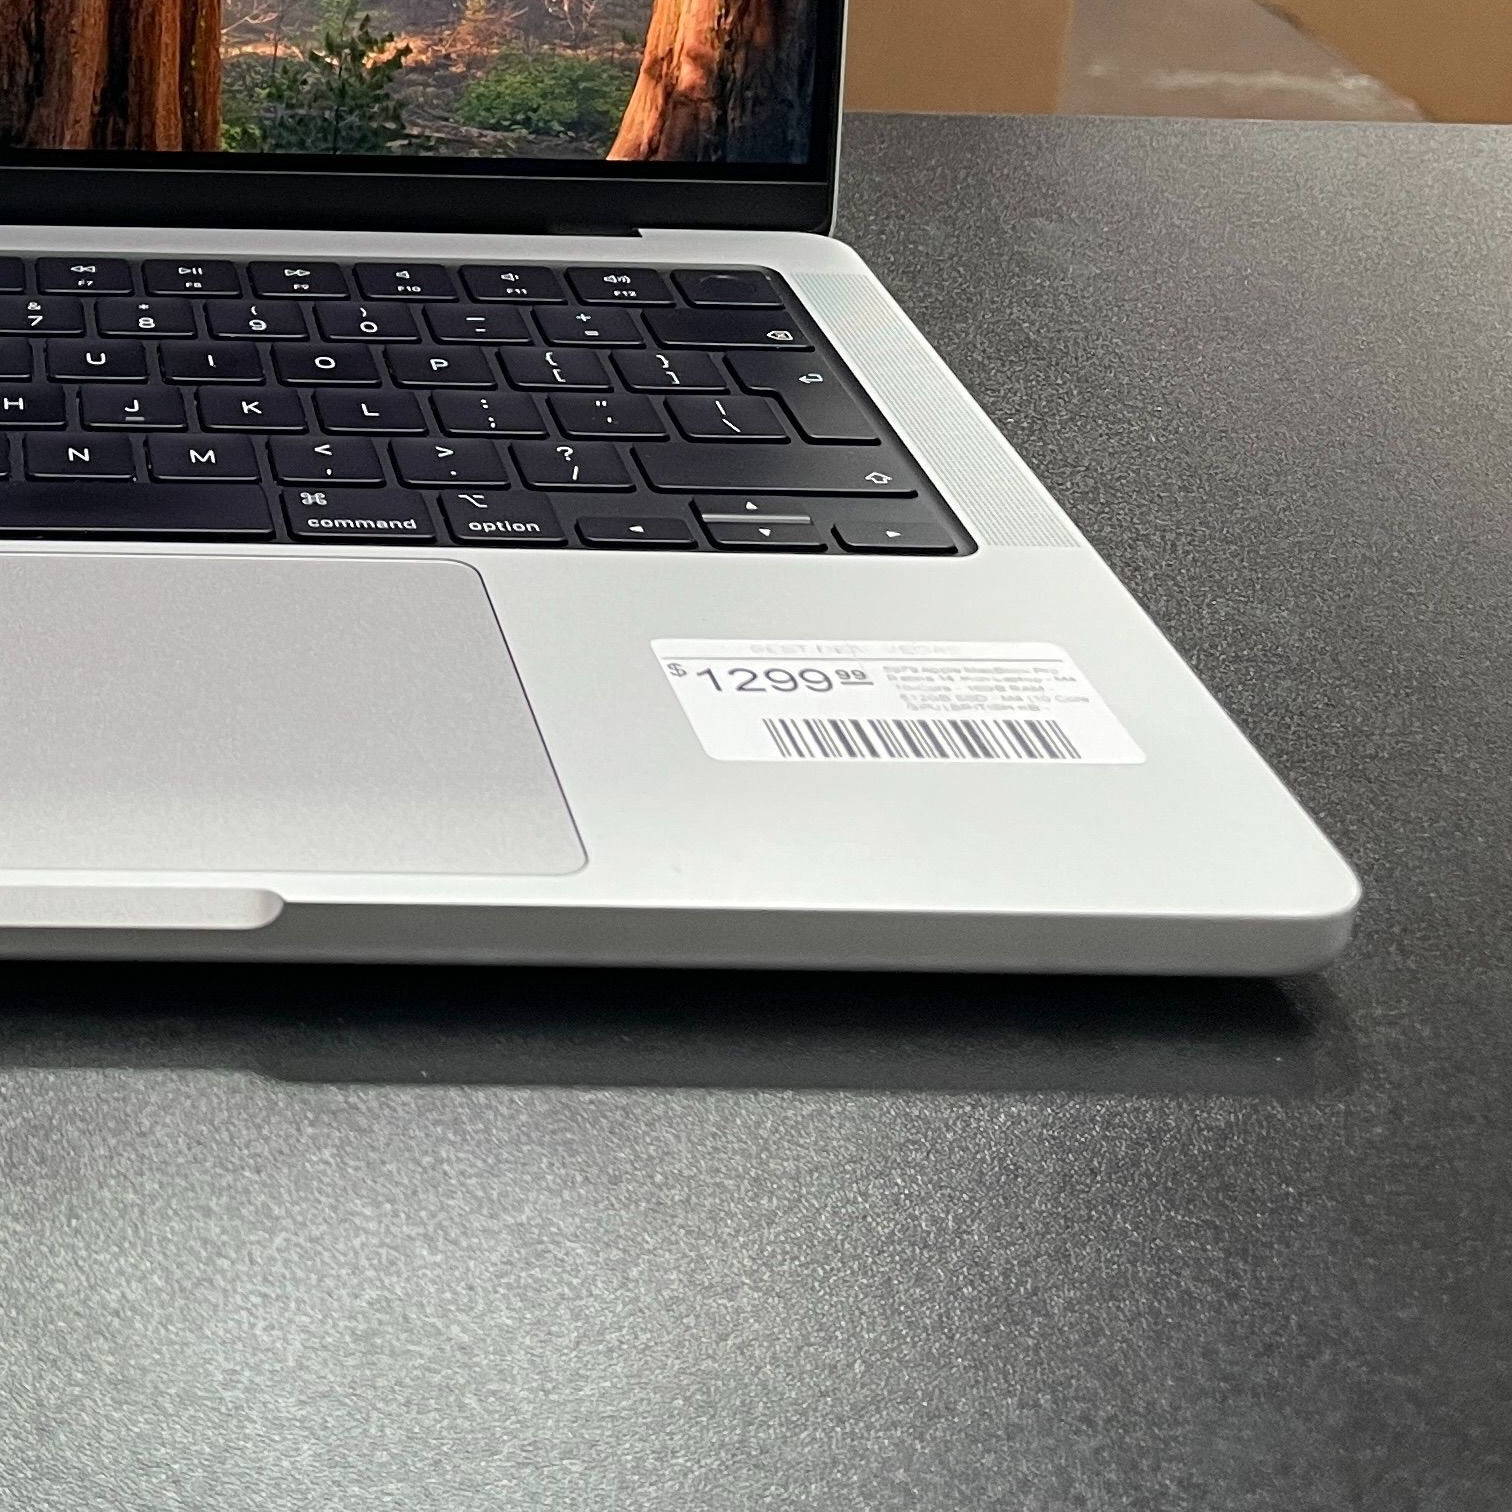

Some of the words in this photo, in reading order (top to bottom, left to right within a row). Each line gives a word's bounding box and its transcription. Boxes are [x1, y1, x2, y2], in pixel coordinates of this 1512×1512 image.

[27, 315, 44, 327] 7
[138, 316, 156, 329] 8
[248, 319, 267, 331] 9
[85, 352, 106, 365] U
[314, 356, 336, 369] O
[429, 358, 449, 371] P
[3, 397, 24, 410] H
[124, 399, 140, 413] J
[241, 401, 263, 414] K
[361, 403, 380, 417] L
[68, 447, 90, 462] N
[189, 449, 216, 464] M
[307, 518, 417, 530] command
[468, 520, 541, 533] option
